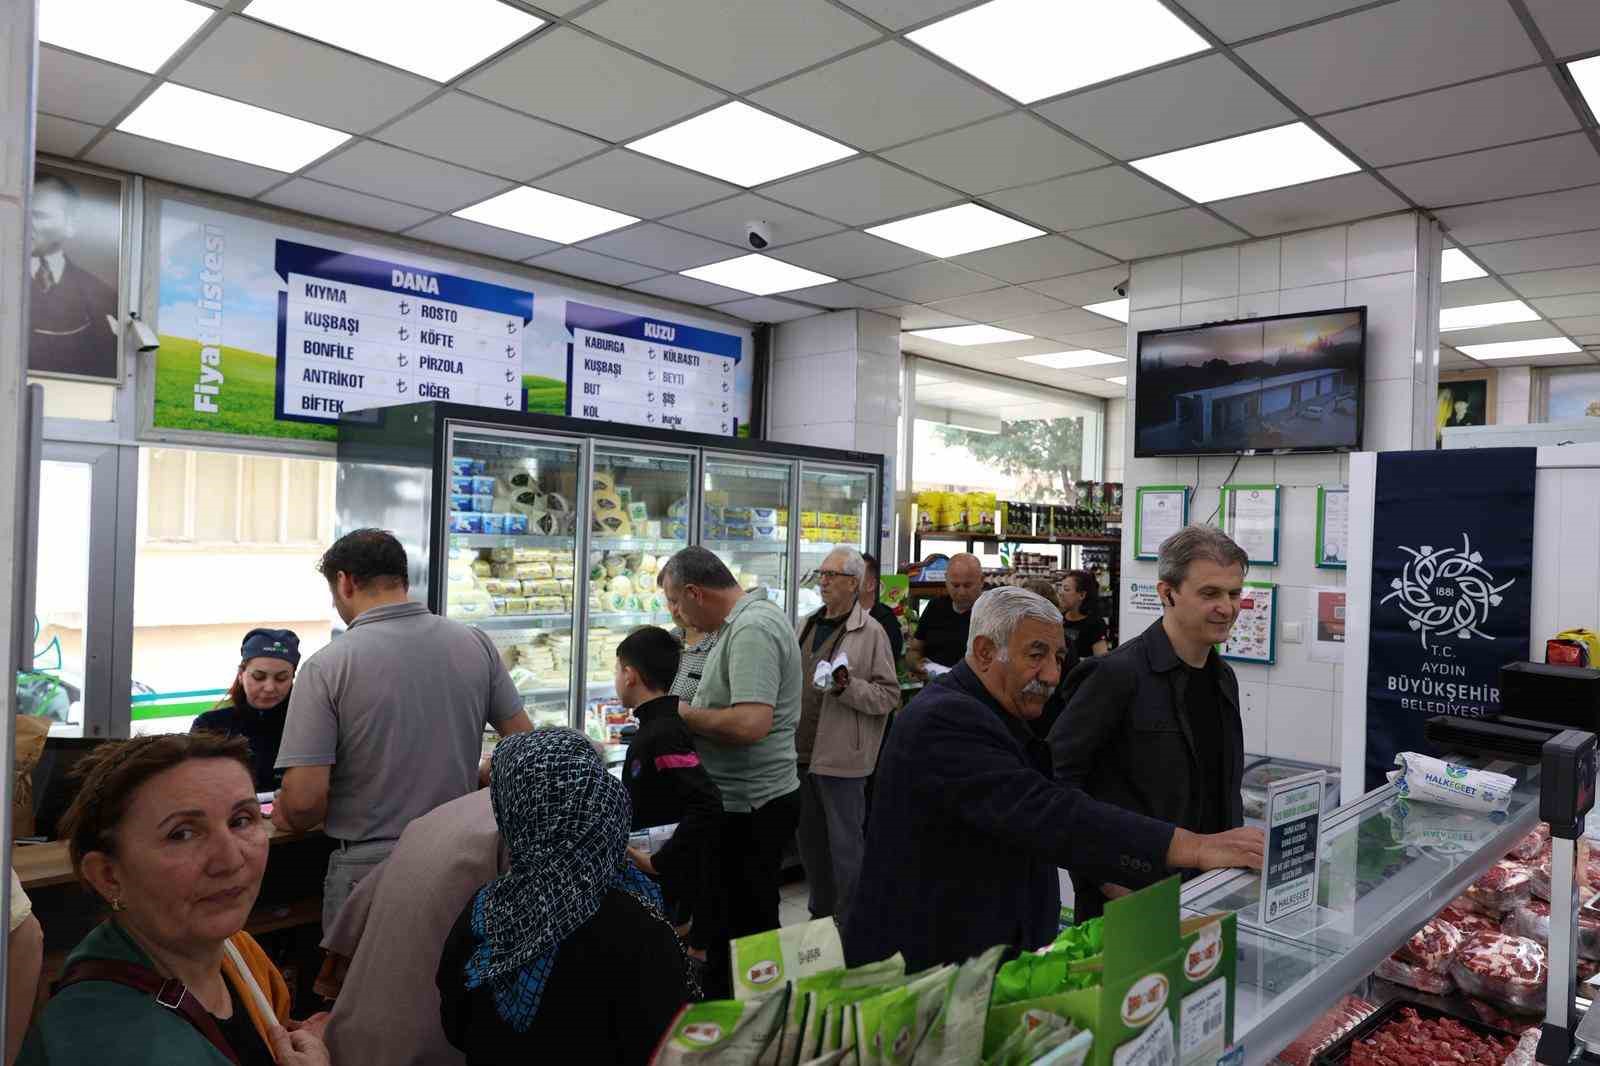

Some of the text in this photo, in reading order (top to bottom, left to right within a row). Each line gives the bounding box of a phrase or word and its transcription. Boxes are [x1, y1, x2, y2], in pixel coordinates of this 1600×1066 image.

[200, 224, 224, 327] Listesi
[392, 270, 439, 295] DANA
[305, 283, 347, 303] KIYMA
[421, 304, 458, 323] ROSTO
[304, 311, 359, 336] KUŞBAŞI
[644, 322, 675, 341] KUZU
[420, 328, 454, 348] KÖFTE
[585, 336, 625, 353] KABURGA
[304, 340, 354, 360] BONFİLE
[663, 349, 700, 367] KÜLBAŞTI
[420, 355, 464, 374] PİRZOLA
[584, 359, 621, 378] KUŞBAŞI
[303, 368, 365, 389] ANTRİKOT
[418, 381, 450, 399] CİĞER
[584, 382, 600, 395] BUT
[302, 394, 344, 414] BİFTEK
[583, 405, 600, 418] KOL
[1431, 645, 1456, 658] T.C.
[1421, 662, 1465, 676] AYDIN
[1387, 674, 1500, 703] BÜYÜKŞEHİR
[1401, 698, 1485, 717] BELEDİYESİ
[1425, 773, 1477, 795] HALKEGEET
